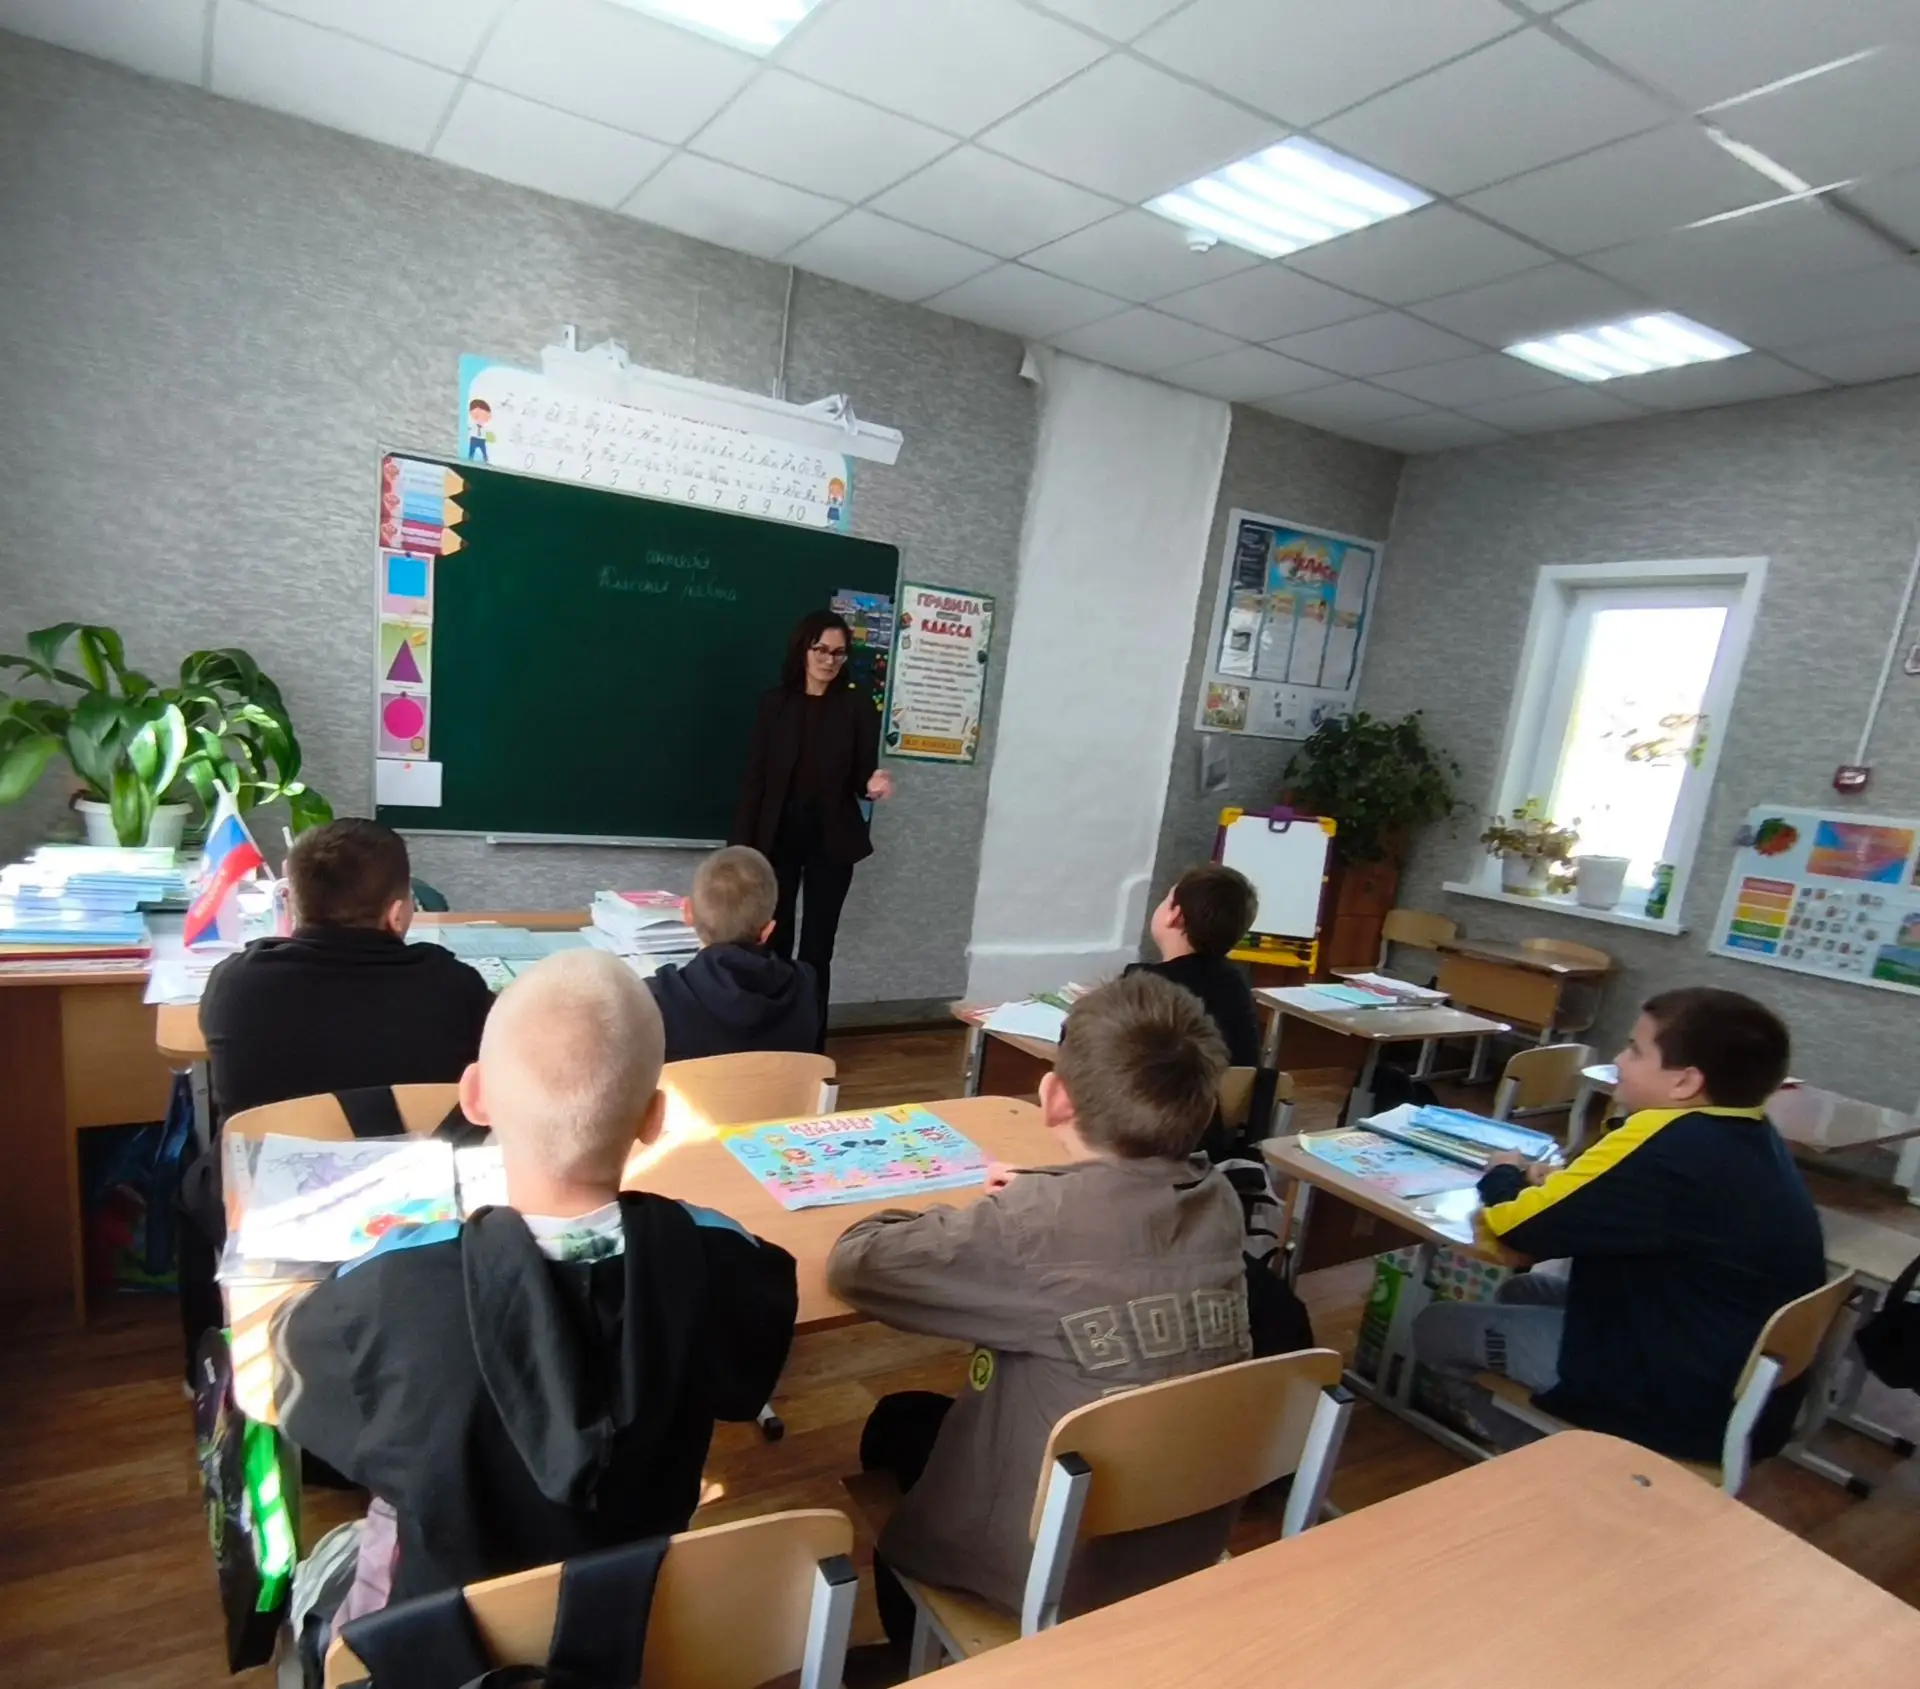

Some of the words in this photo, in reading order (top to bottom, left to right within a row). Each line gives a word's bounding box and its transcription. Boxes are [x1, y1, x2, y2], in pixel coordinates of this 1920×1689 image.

[524, 452, 535, 470] 0
[580, 464, 592, 479] 2
[662, 479, 673, 495] 5
[687, 484, 698, 501] 6
[713, 489, 722, 504] 7
[738, 494, 748, 510] 8
[762, 498, 772, 514] 9
[786, 504, 806, 520] 10
[916, 593, 981, 616] ПРАВИЛА
[921, 619, 973, 638] КЛАССА
